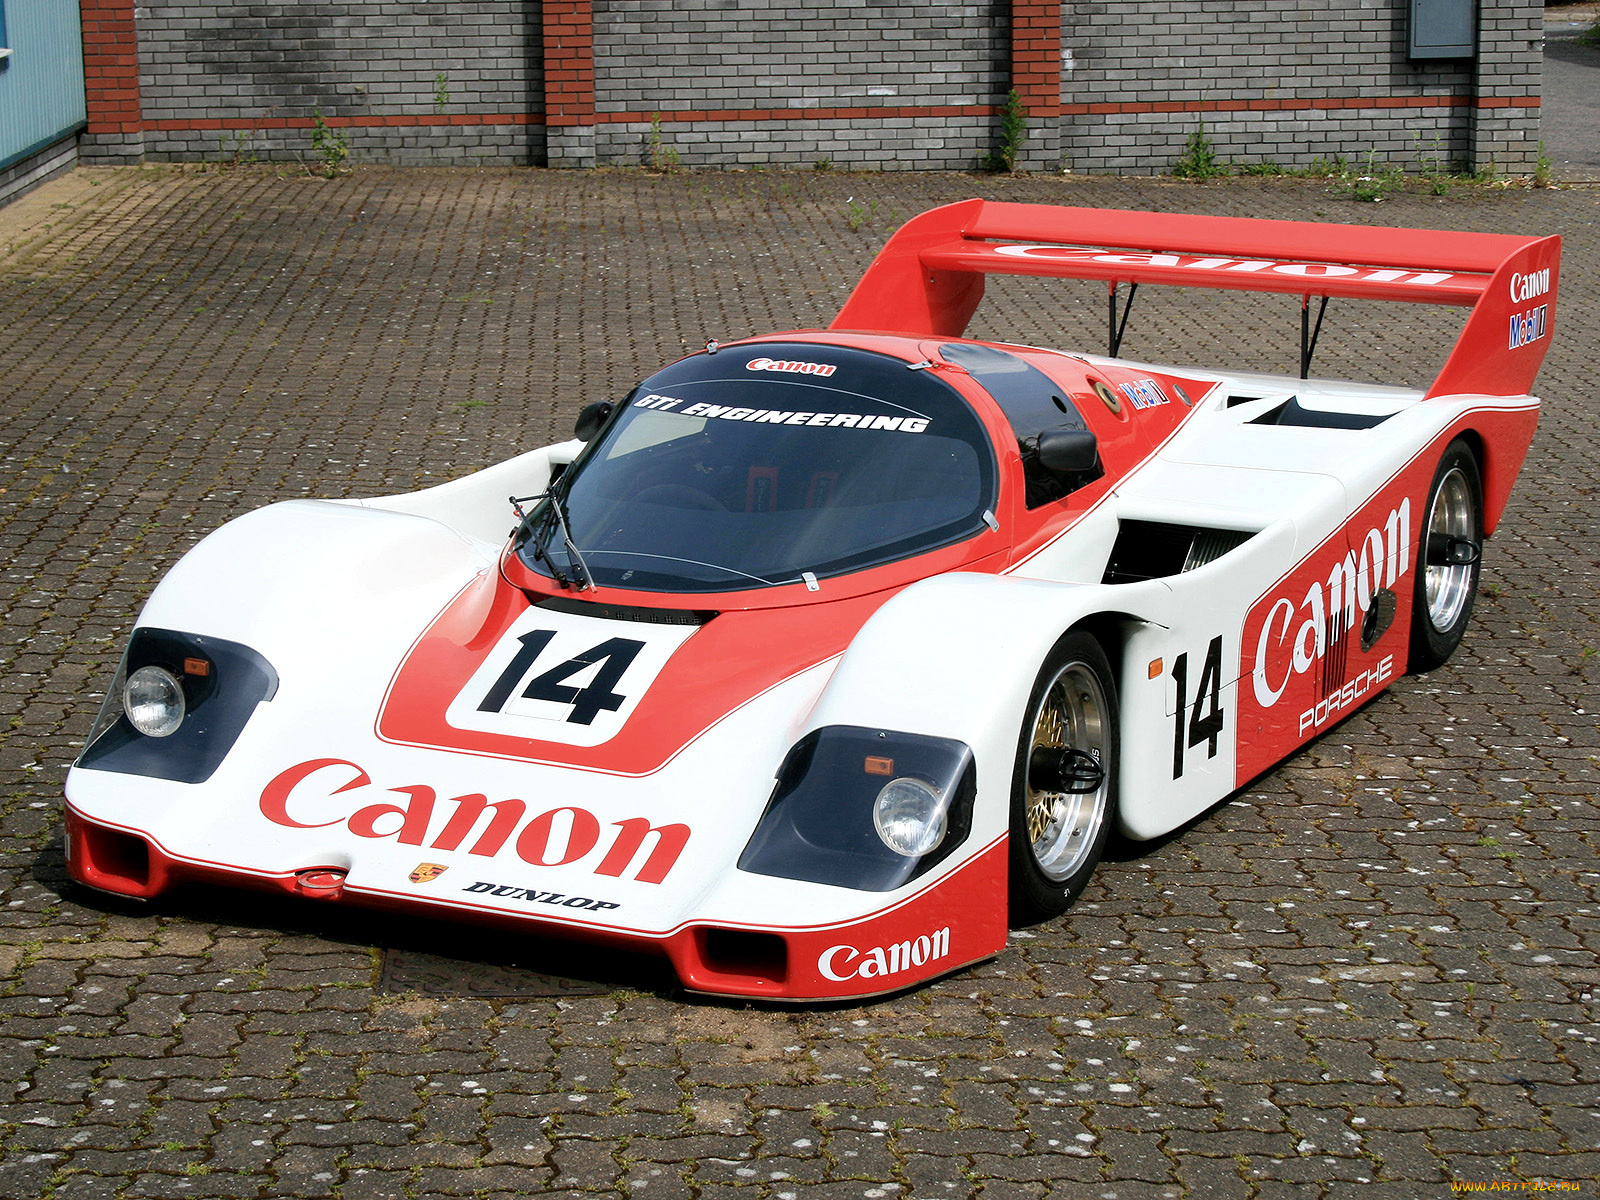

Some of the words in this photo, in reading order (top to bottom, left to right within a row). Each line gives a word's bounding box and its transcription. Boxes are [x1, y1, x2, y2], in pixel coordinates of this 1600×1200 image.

[994, 245, 1454, 285] Canon
[1509, 268, 1550, 303] Canon
[1508, 307, 1539, 350] Mobil
[746, 358, 837, 377] Canon
[634, 394, 683, 410] GTi
[680, 402, 931, 433] ENGINEERING
[1119, 380, 1161, 410] Mobil
[1252, 497, 1410, 708] Canon
[476, 629, 647, 726] 14
[1299, 653, 1393, 738] PORSCHE
[1171, 634, 1224, 781] 14
[259, 757, 691, 885] Canon
[462, 881, 621, 912] DUNLOP
[817, 926, 950, 982] Canon
